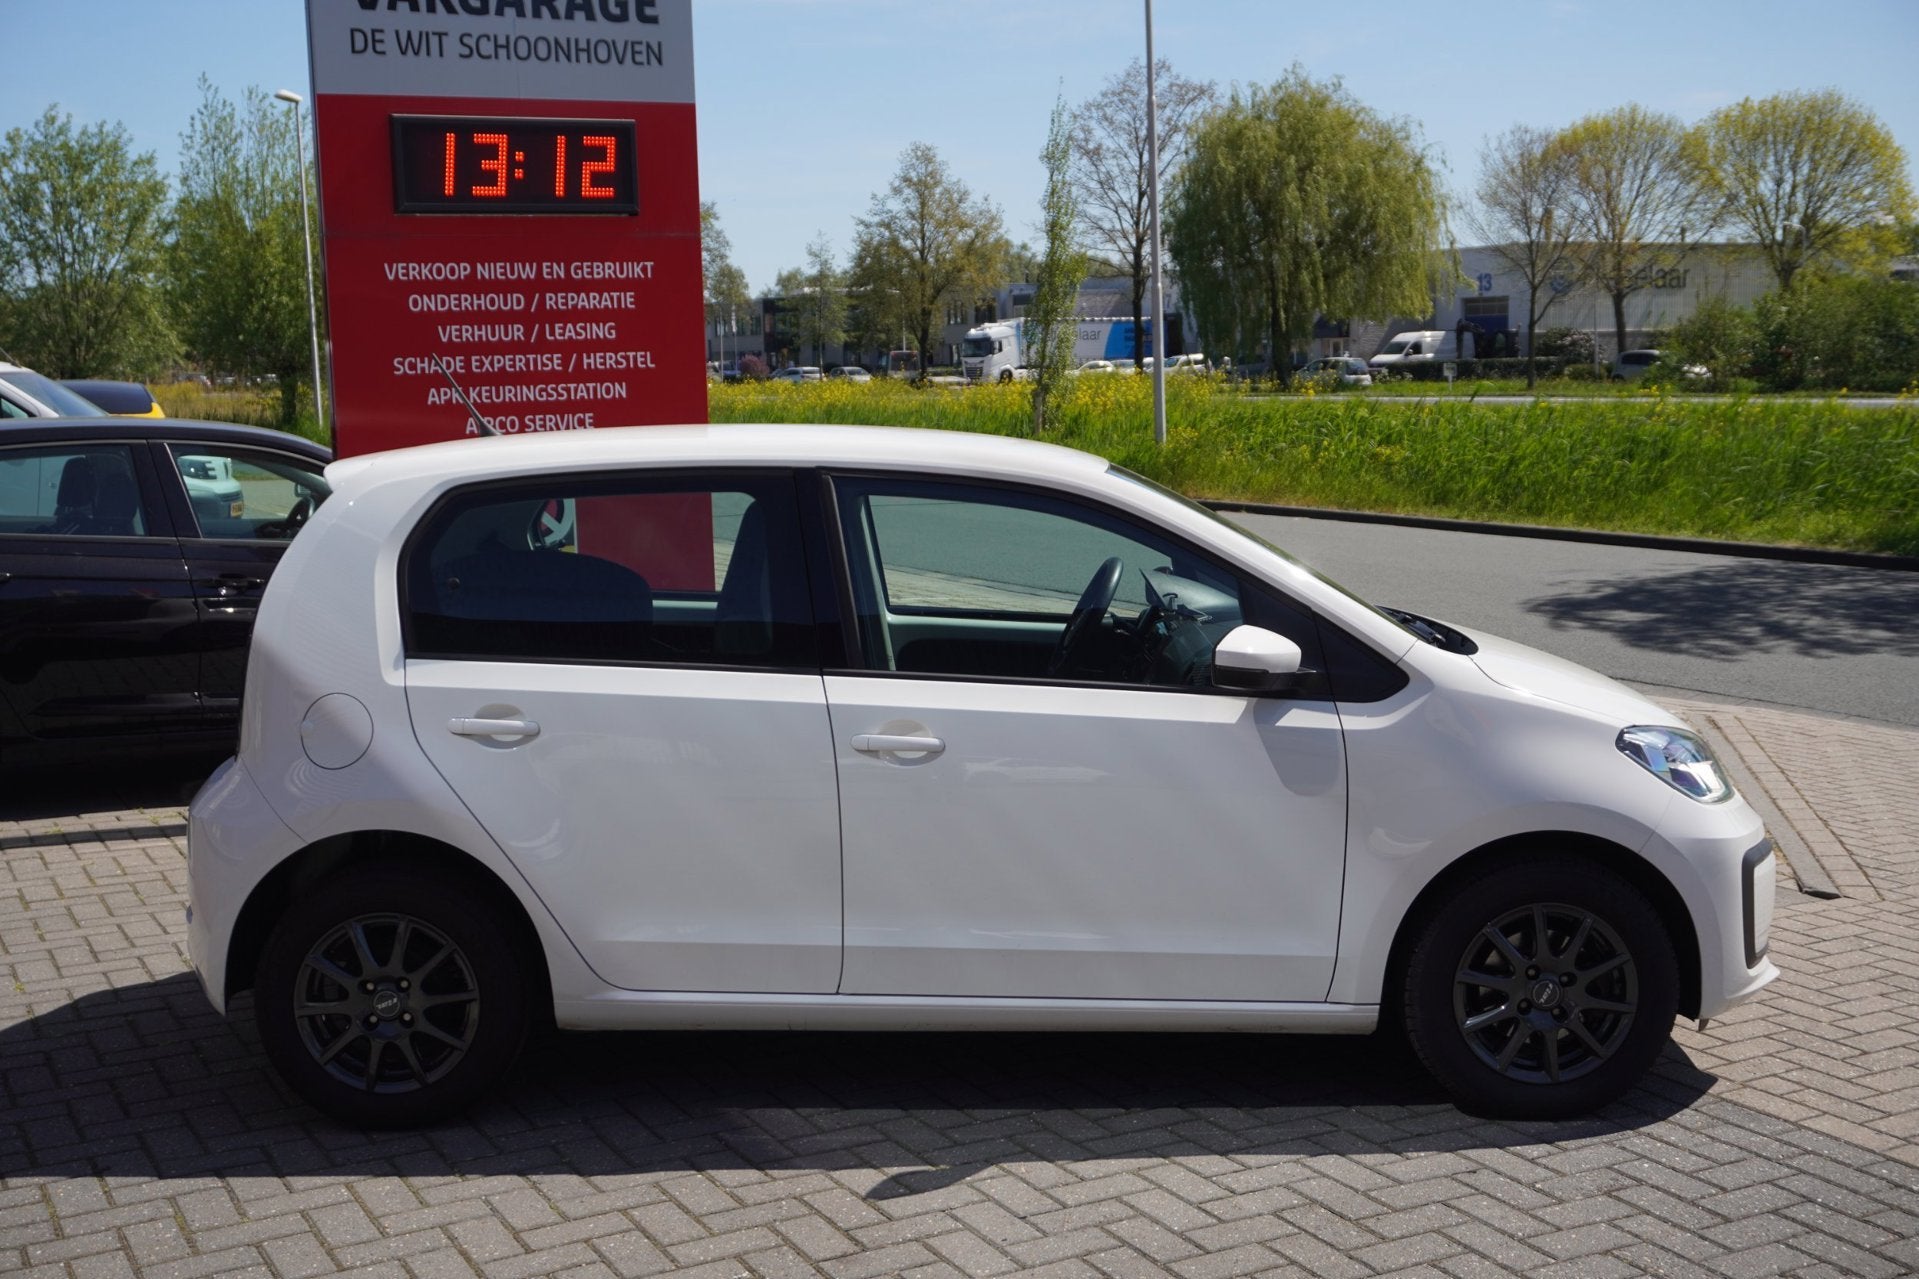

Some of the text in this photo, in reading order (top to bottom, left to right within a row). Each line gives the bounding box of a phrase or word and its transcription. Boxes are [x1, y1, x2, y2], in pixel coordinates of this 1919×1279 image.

[349, 27, 664, 67] DE WIT SCHOONHOVEN
[444, 133, 617, 198] 13:12
[384, 261, 655, 280] VERKOOP NIEUW EN GEBRUIKT
[1477, 273, 1492, 291] 13
[408, 292, 636, 313] ONDERHOUD / REPARATIE
[437, 322, 617, 343] VERHUUR / LEASING
[393, 351, 656, 375] SCHADE EXPERTISE / HERSTEL
[427, 382, 627, 405] APK KEURINGSSTATION
[524, 413, 595, 432] SERVICE
